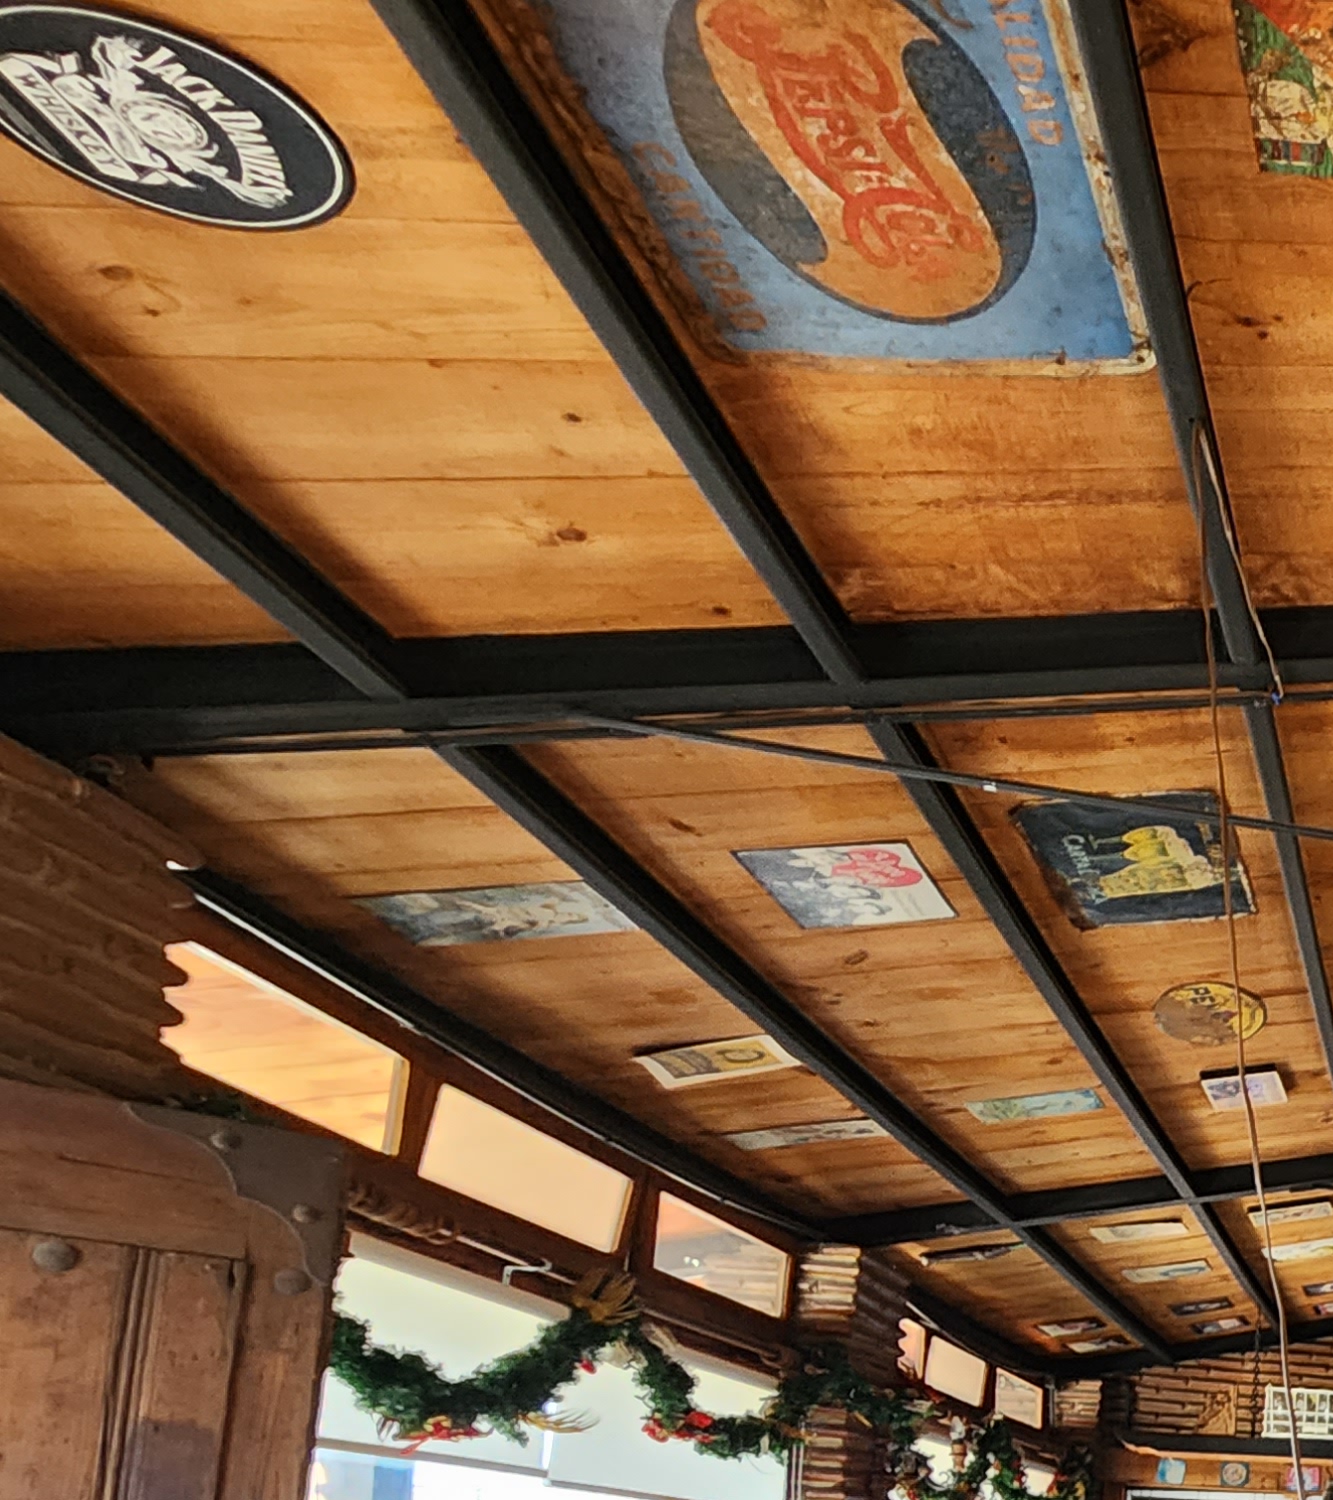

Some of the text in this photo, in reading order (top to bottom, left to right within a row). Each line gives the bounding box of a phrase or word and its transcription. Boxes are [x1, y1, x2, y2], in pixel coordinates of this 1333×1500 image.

[15, 73, 122, 169] WHISKEY
[133, 46, 236, 111] JACK
[989, 0, 1065, 147] LIDAD
